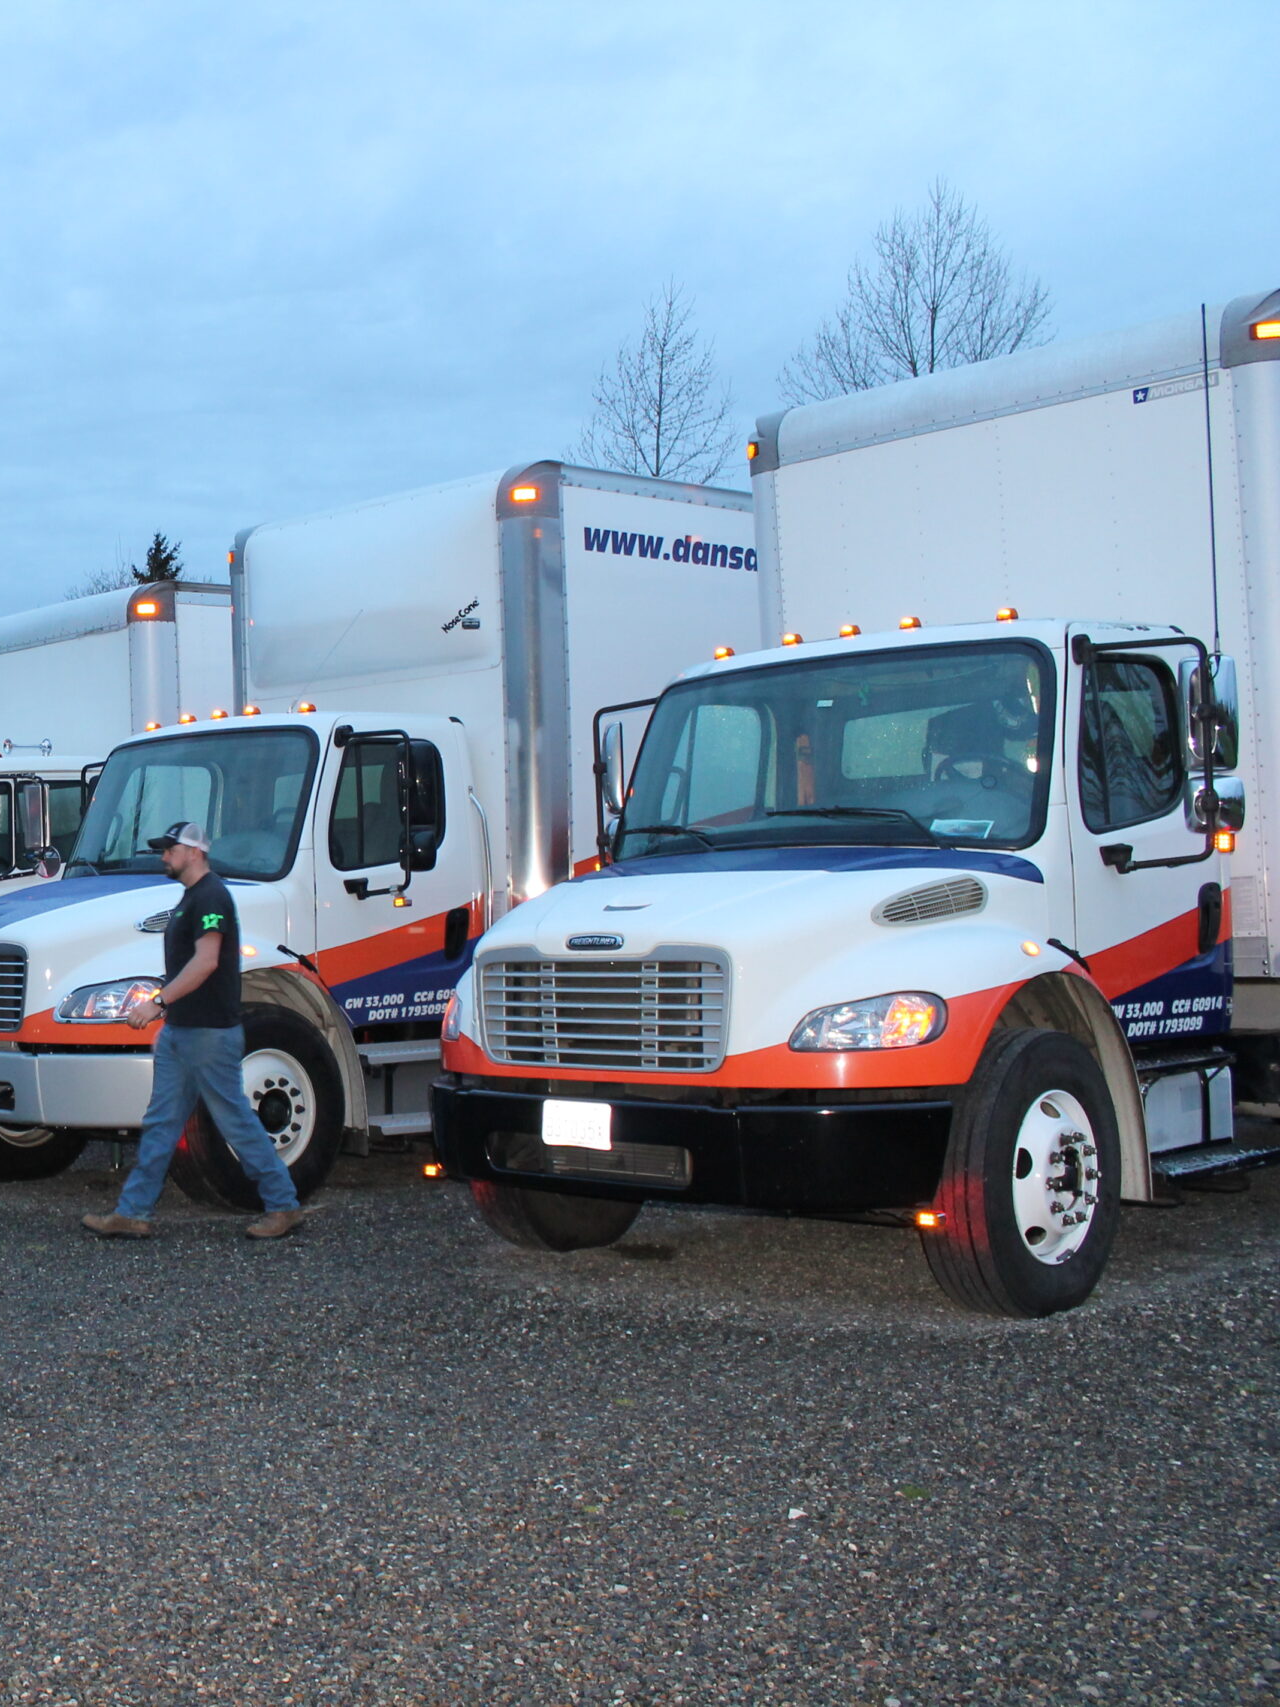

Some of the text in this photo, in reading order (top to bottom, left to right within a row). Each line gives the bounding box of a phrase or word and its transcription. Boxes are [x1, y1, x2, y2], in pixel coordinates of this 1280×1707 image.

[345, 997, 364, 1010] GW
[365, 993, 405, 1008] 33,000
[414, 991, 435, 1003] CC#
[1126, 1001, 1164, 1019] 33,000
[1171, 999, 1191, 1014] CC#
[1192, 995, 1223, 1012] 60914
[368, 1008, 399, 1021] DOT#
[1127, 1015, 1203, 1037] DOT# 1793099
